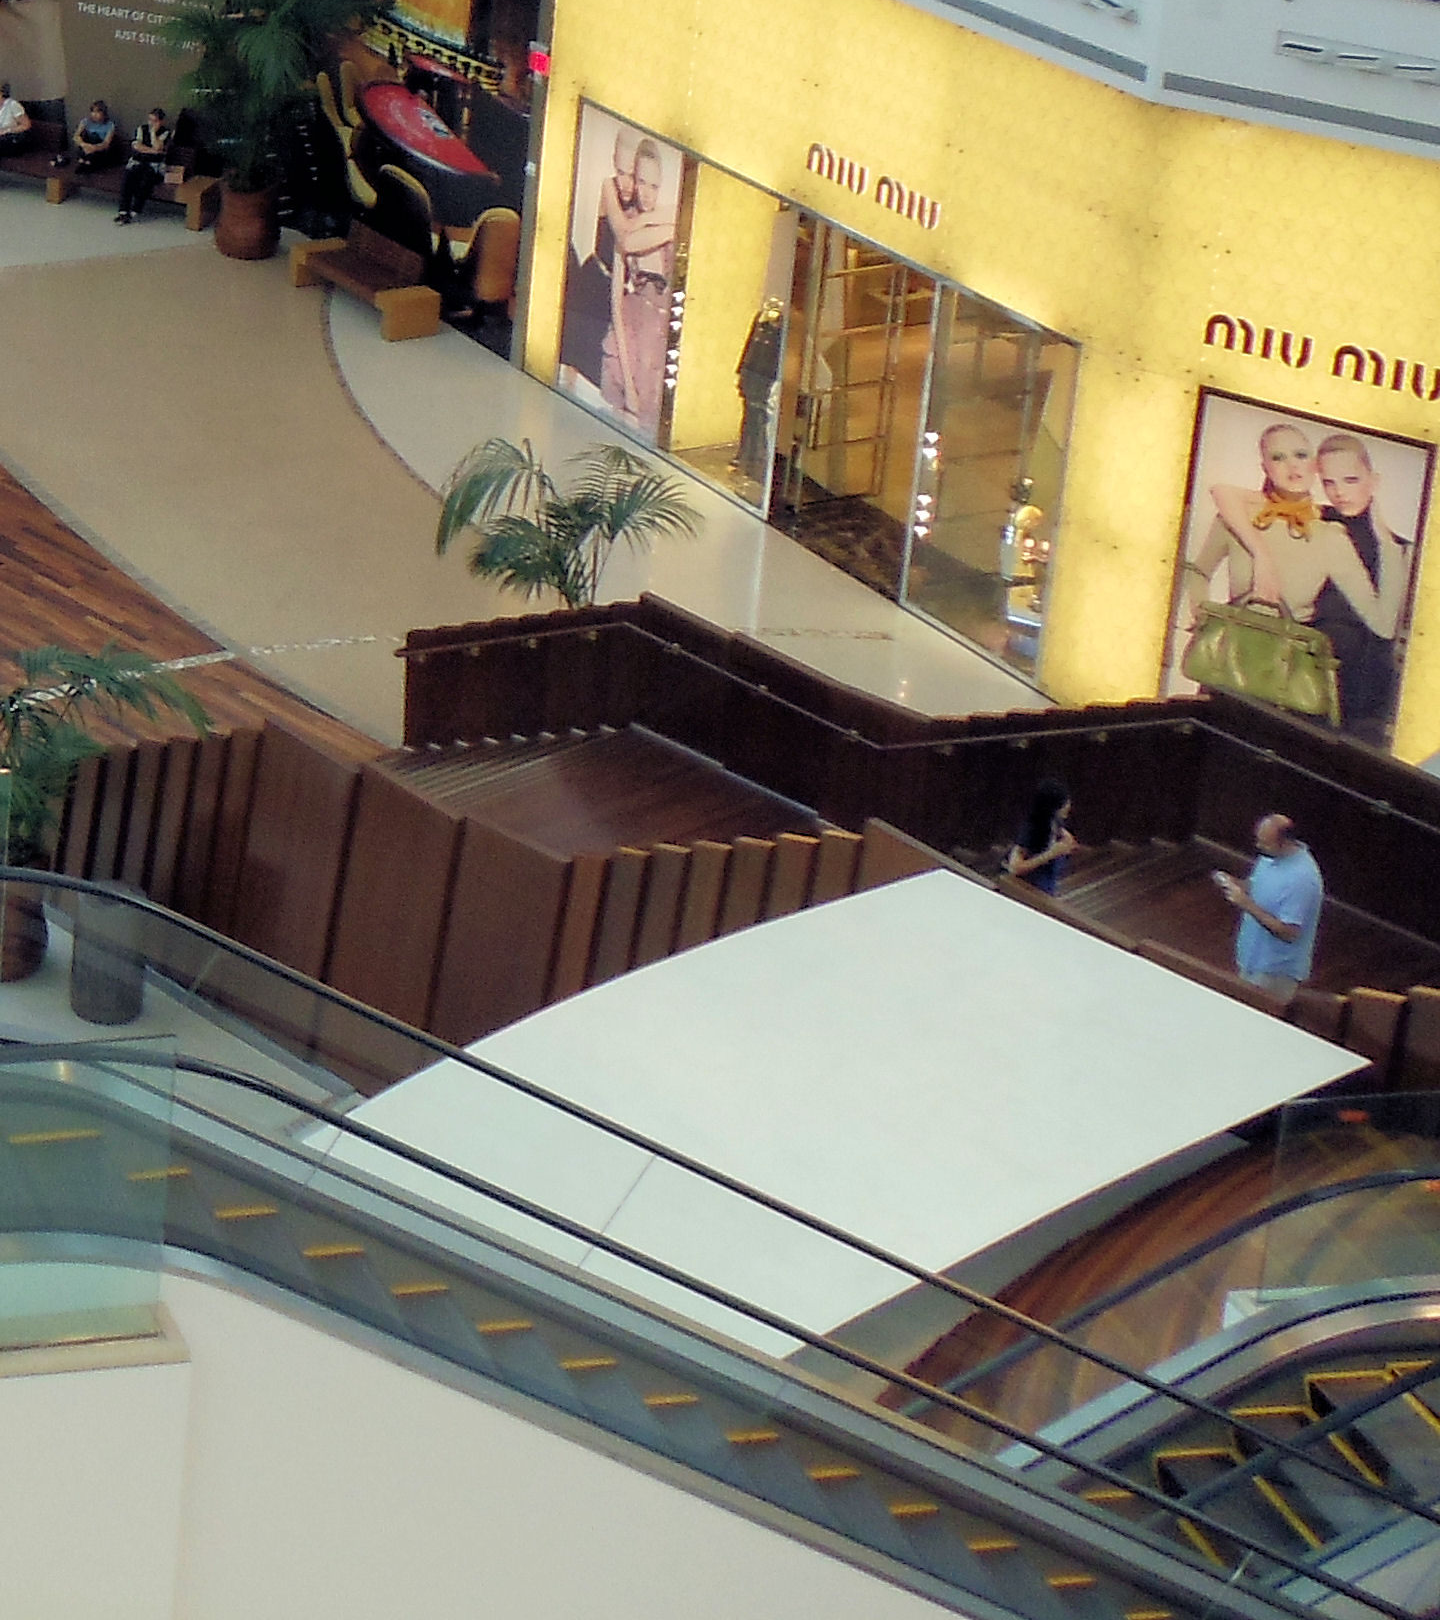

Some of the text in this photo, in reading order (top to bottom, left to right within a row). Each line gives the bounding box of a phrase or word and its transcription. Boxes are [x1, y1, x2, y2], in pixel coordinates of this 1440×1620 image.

[78, 1, 97, 14] THE
[97, 5, 130, 20] HEART
[131, 10, 146, 22] OF
[114, 29, 137, 42] JUST
